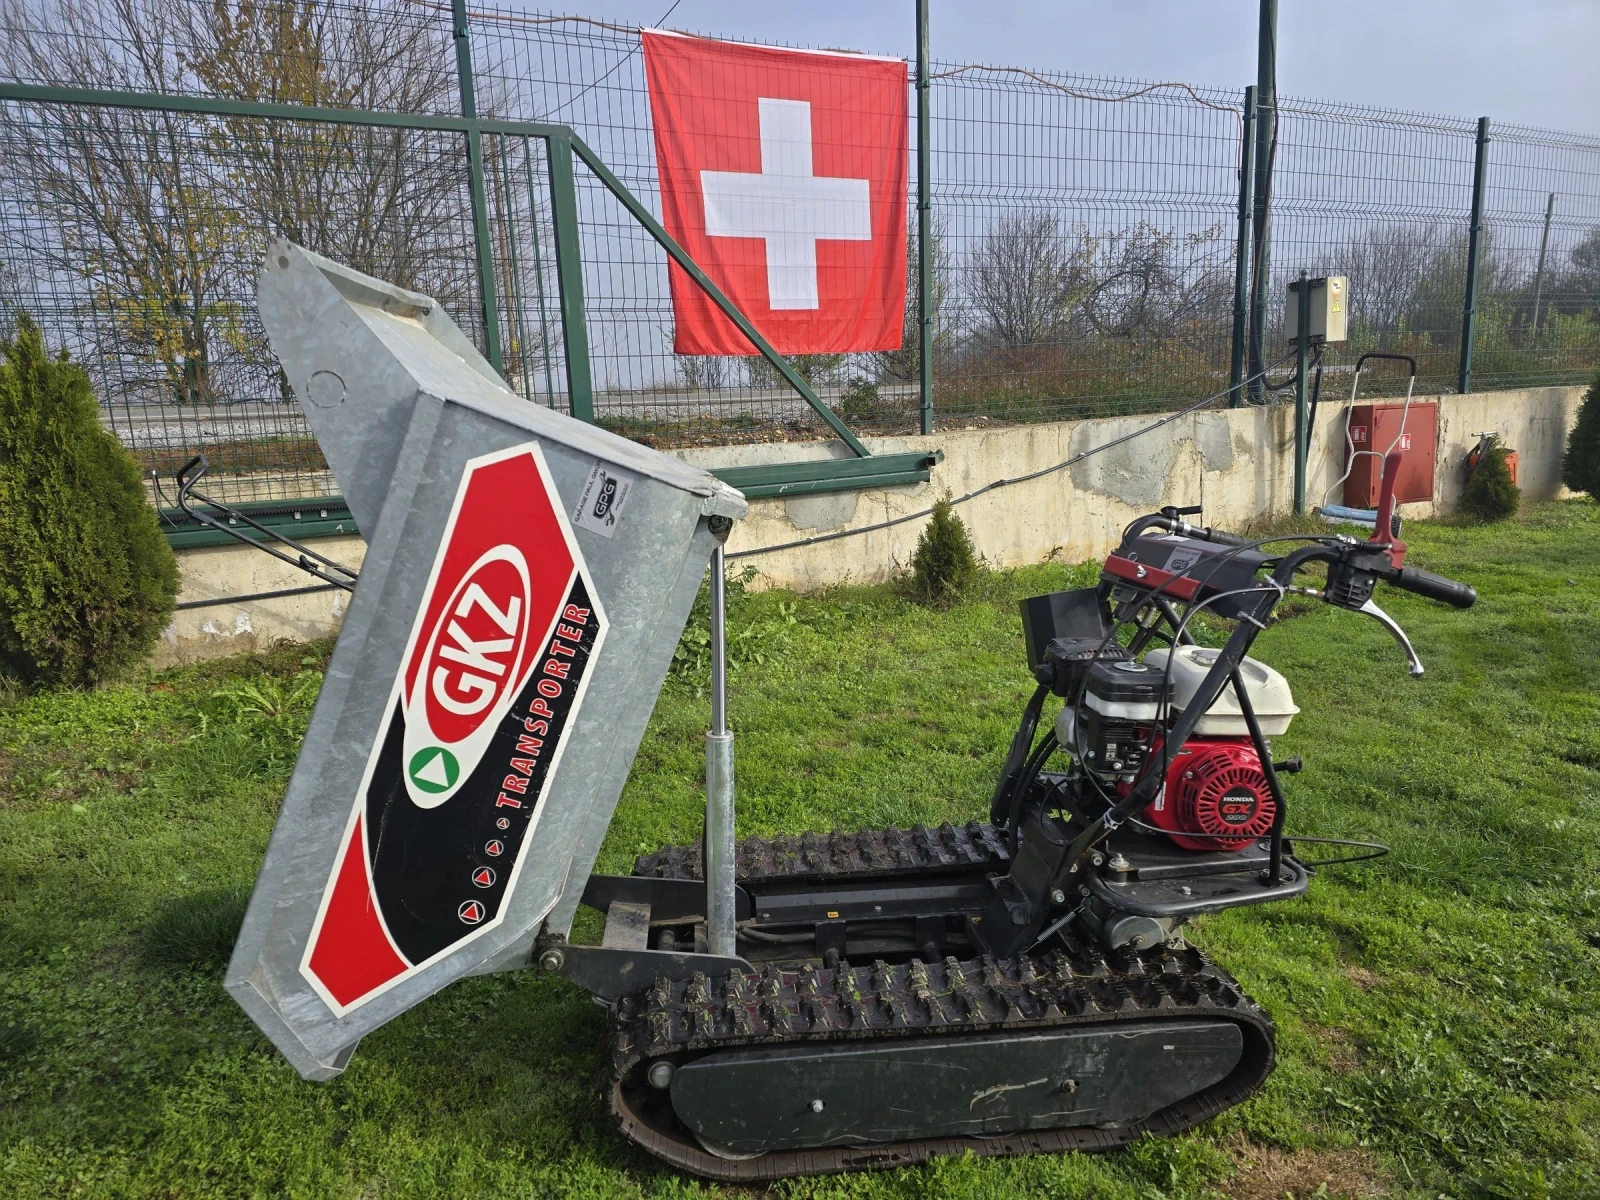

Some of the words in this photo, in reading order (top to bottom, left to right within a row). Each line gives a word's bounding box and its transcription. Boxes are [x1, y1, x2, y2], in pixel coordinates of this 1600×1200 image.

[574, 495, 588, 522] GARAGE
[584, 480, 595, 496] PAUL
[595, 483, 615, 515] GPG
[1172, 560, 1187, 569] GPG
[432, 582, 522, 716] GKZ
[496, 603, 590, 809] TRANSPORTER
[1222, 803, 1252, 814] GX
